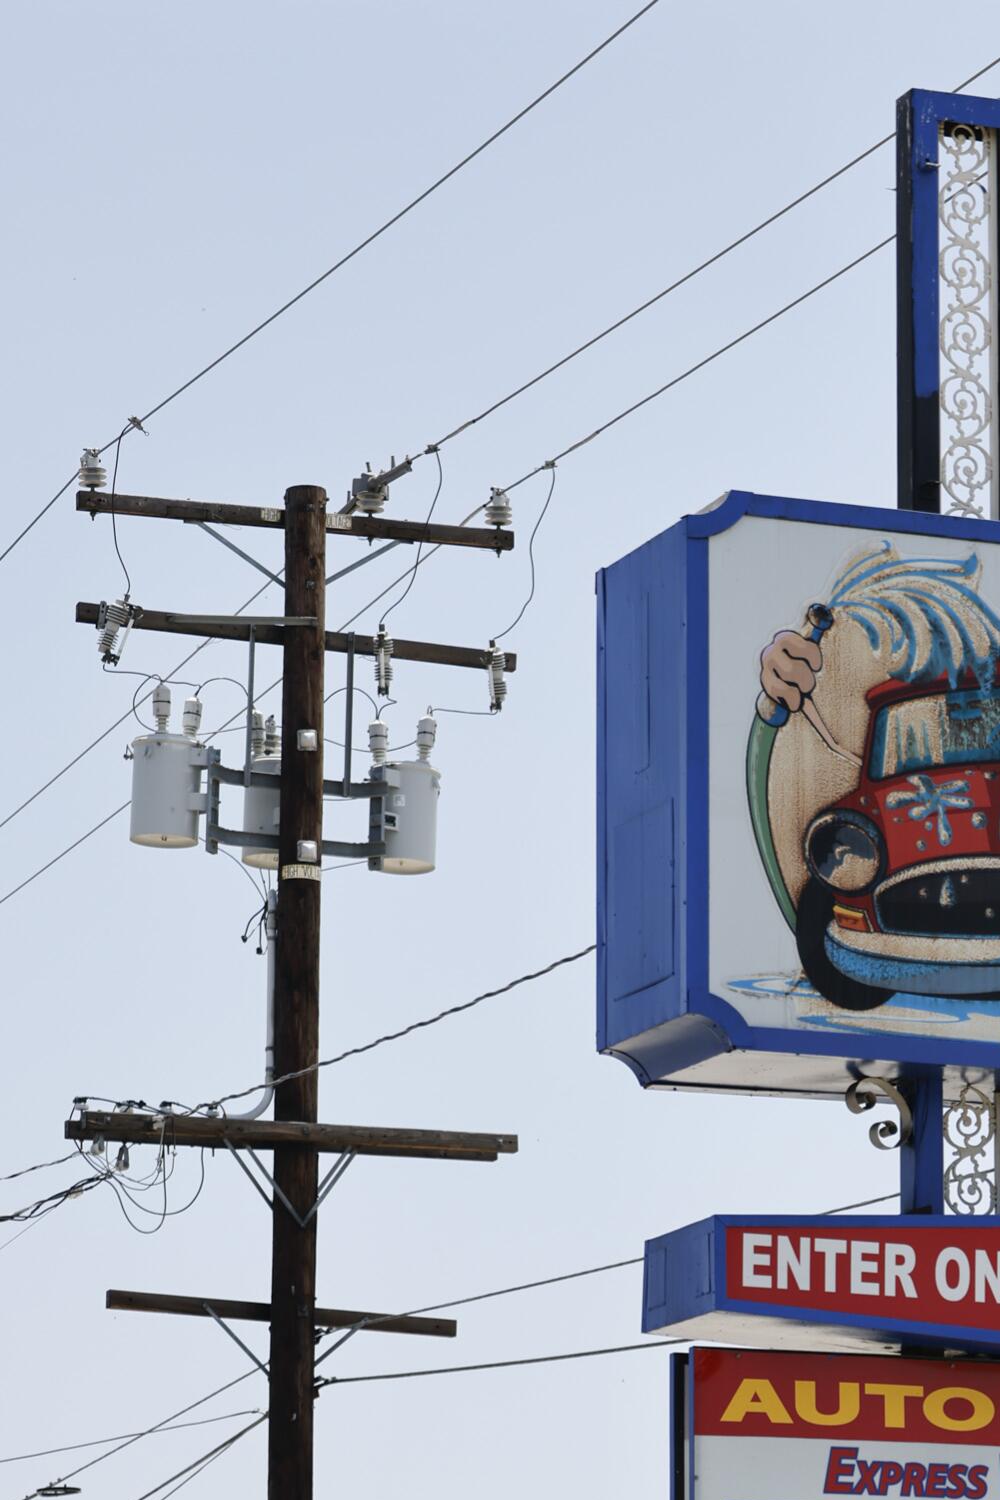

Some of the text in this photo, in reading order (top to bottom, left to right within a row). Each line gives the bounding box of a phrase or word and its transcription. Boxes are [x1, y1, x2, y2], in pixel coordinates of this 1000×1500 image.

[741, 1231, 918, 1299] ENTER
[720, 1378, 996, 1432] AUTO
[823, 1446, 990, 1500] EXPRESS
